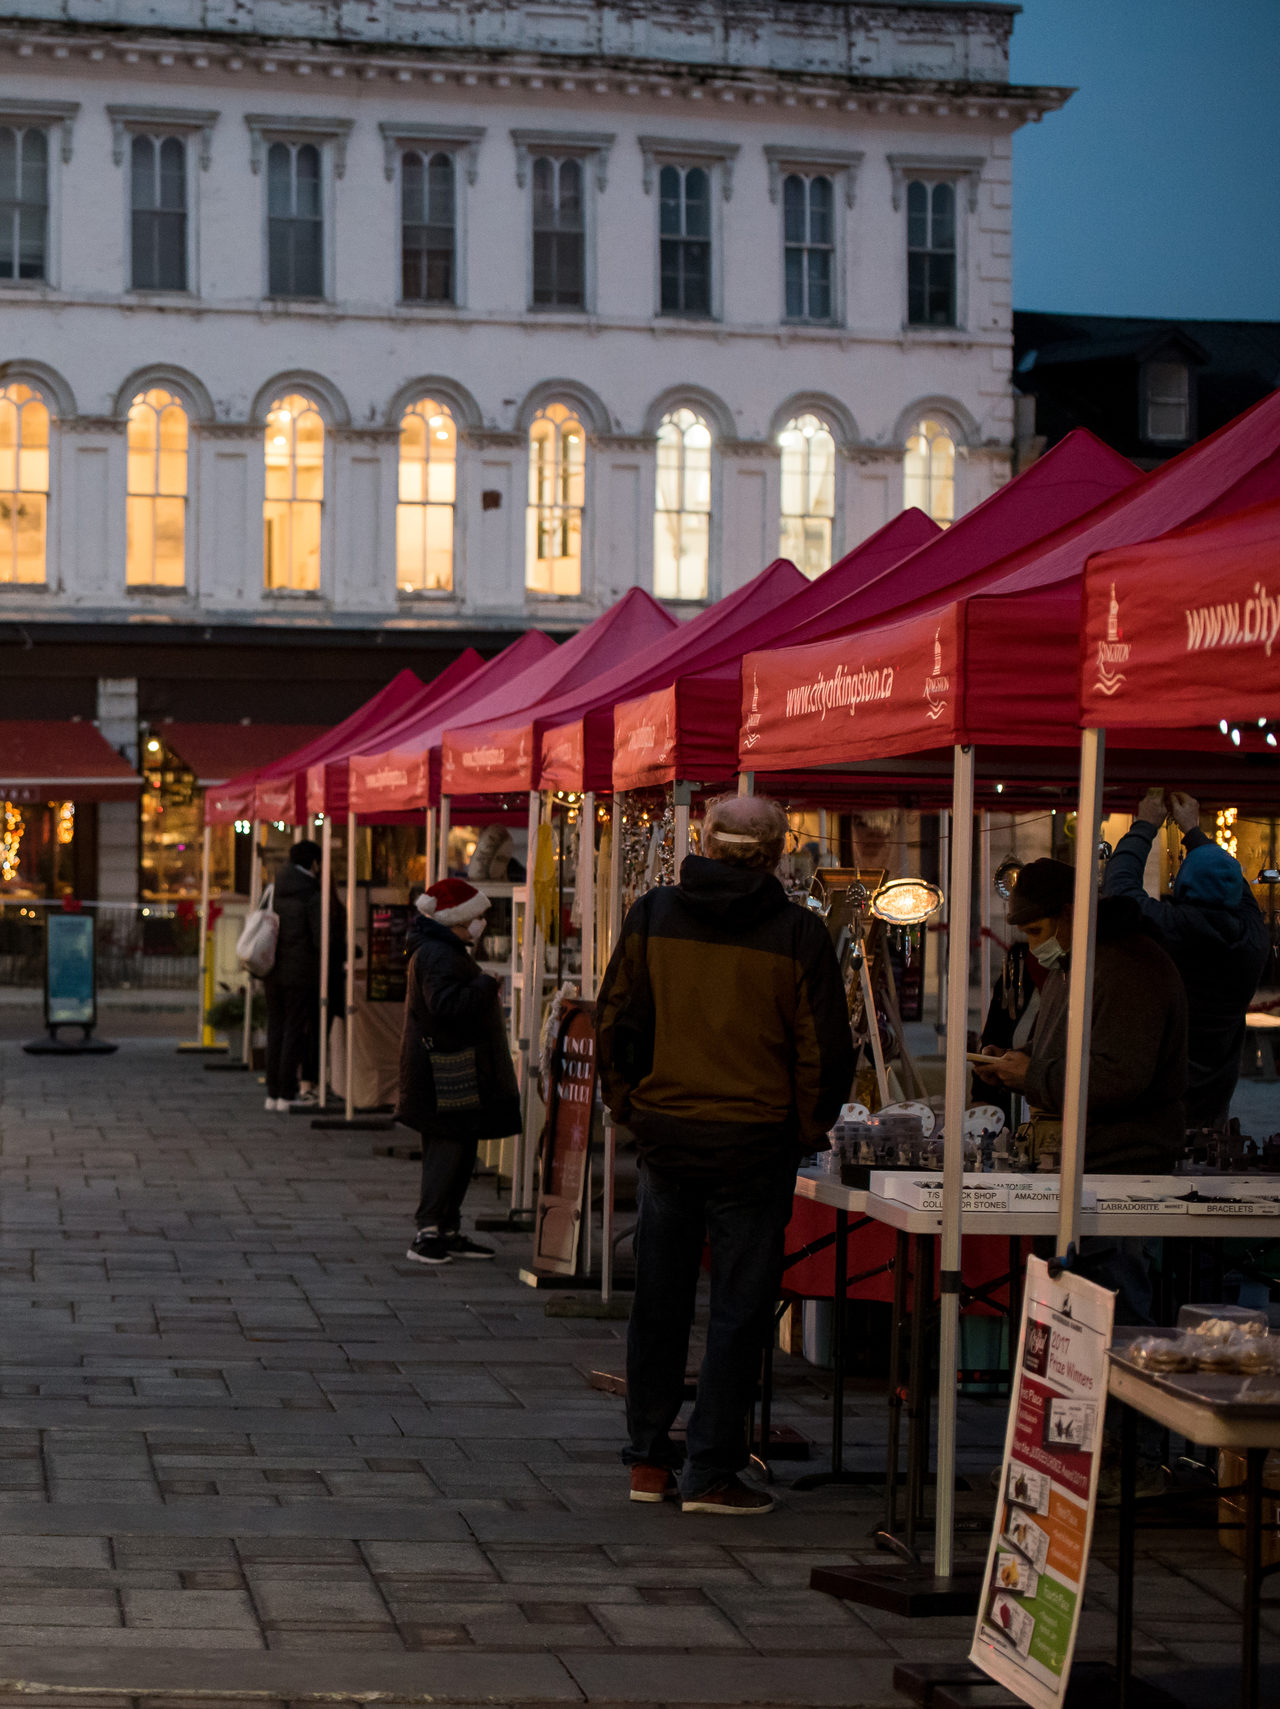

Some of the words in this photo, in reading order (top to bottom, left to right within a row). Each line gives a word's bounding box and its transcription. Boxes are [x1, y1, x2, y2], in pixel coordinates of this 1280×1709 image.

[786, 665, 894, 721] www.cityofkingston.ca
[974, 1192, 997, 1200] SHOP
[974, 1201, 1007, 1209] STONES
[1101, 1203, 1160, 1211] LABRADORITE
[1207, 1205, 1254, 1213] BRACELETS
[1051, 1331, 1071, 1354] 2017
[1049, 1353, 1066, 1375] Prize
[1066, 1361, 1094, 1390] Winners
